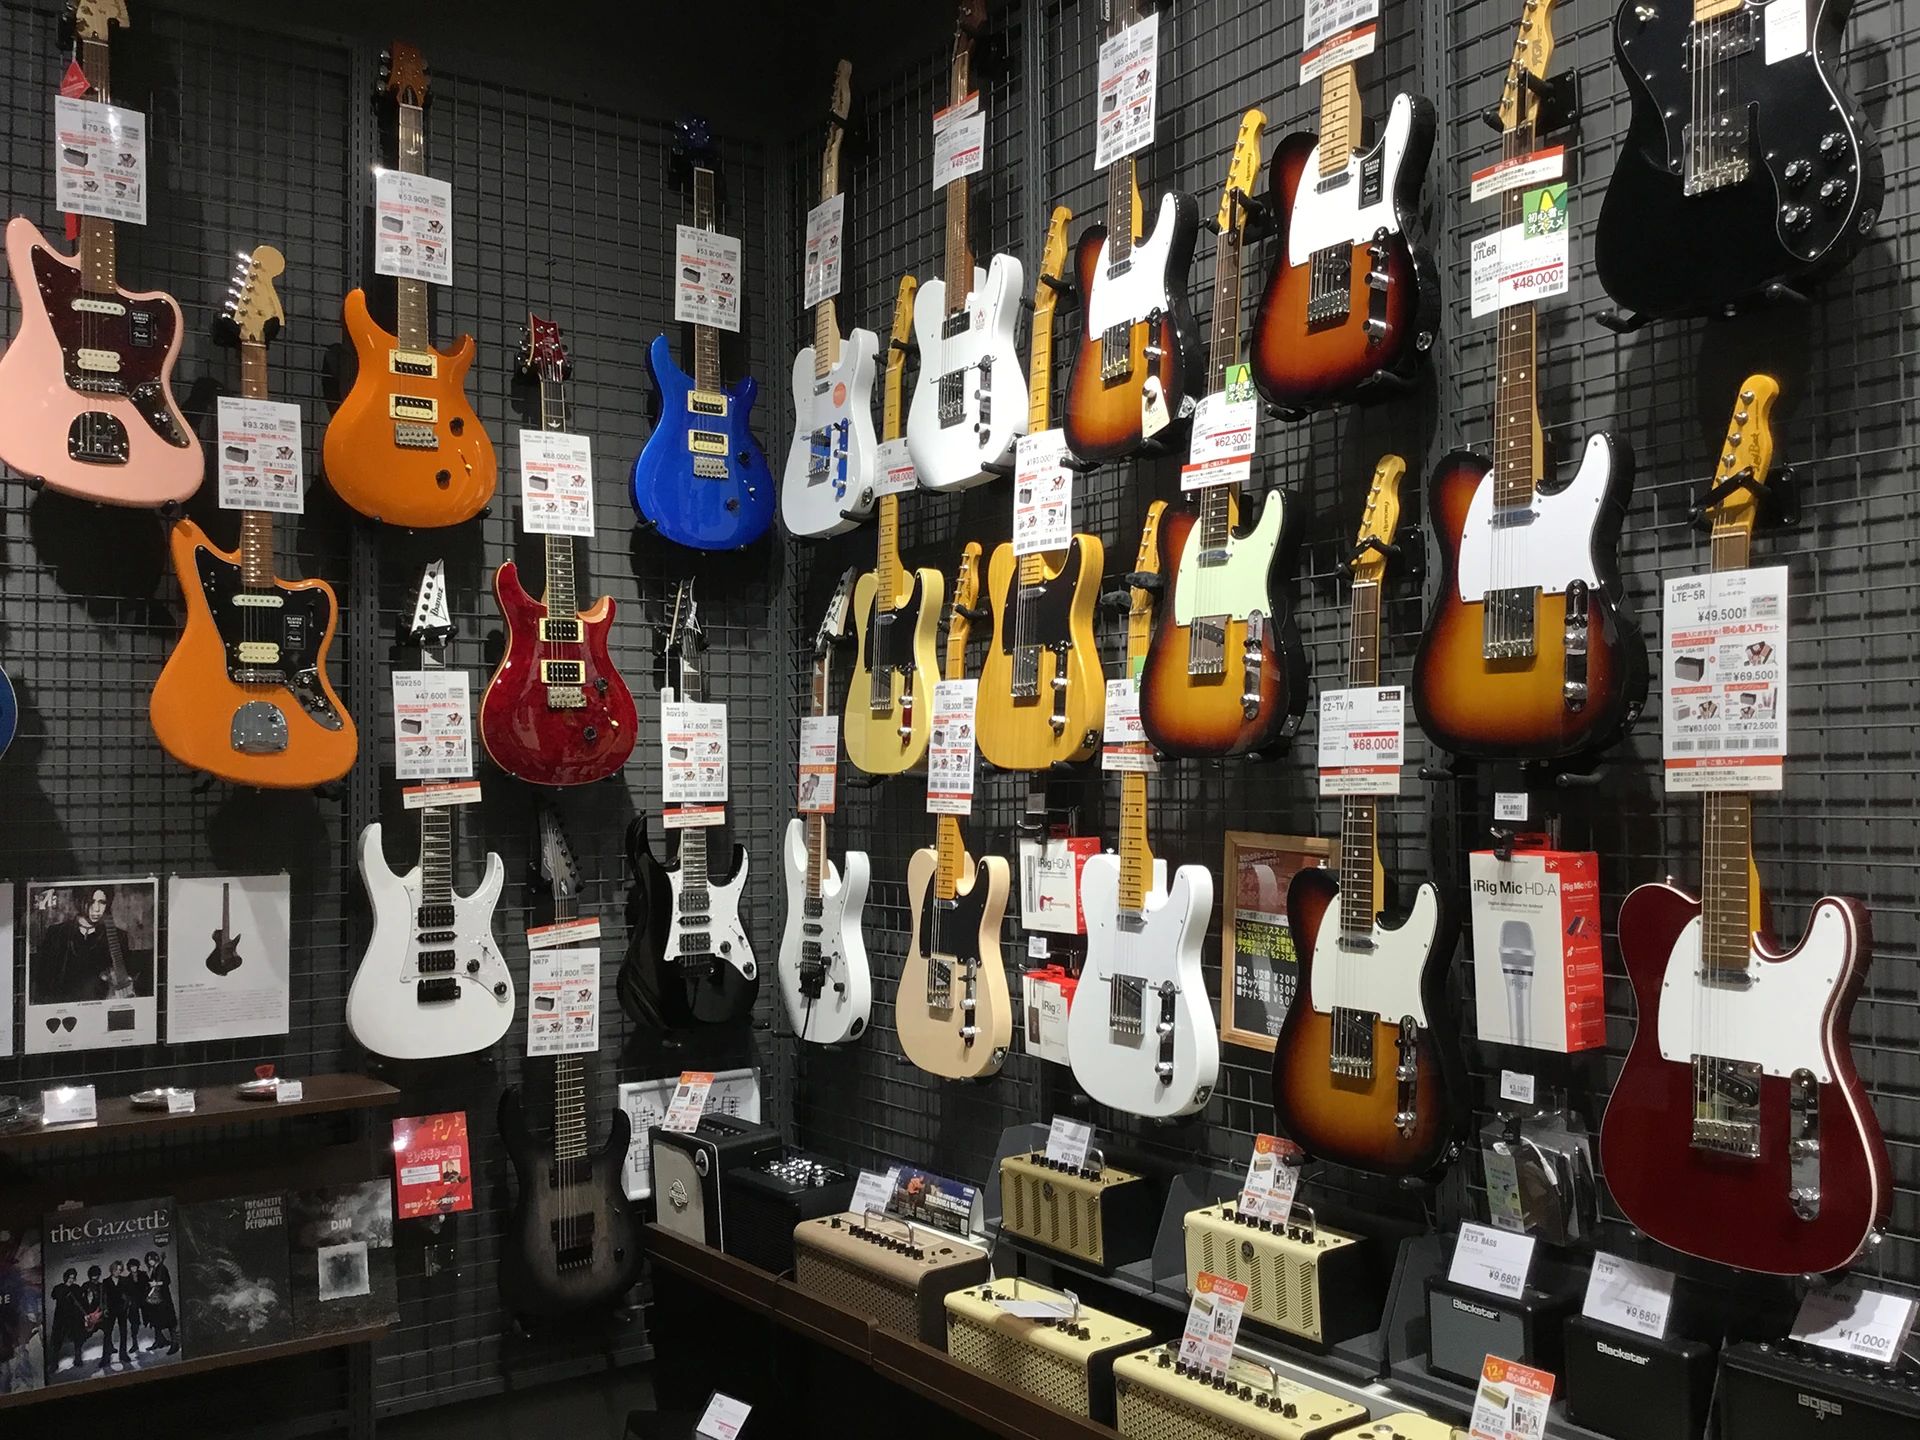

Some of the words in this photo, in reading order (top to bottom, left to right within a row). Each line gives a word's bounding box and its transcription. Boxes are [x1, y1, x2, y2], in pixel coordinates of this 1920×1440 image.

[1528, 218, 1564, 235] オススメ
[1473, 240, 1486, 251] FGN
[1474, 245, 1497, 262] JTL6R
[430, 588, 443, 616] Ibanez
[1672, 590, 1705, 603] LTE-5R
[1323, 701, 1354, 712] CZ-TV/R
[1474, 880, 1497, 896] iRig
[1499, 881, 1523, 894] Mic
[1525, 882, 1557, 896] HD-A
[331, 1218, 352, 1230] DIM
[50, 1224, 82, 1243] the
[1464, 1233, 1478, 1243] FLY3
[1481, 1237, 1497, 1248] BASS
[1453, 1298, 1498, 1319] Blackstar
[1597, 1341, 1648, 1365] Blackstar
[1798, 1393, 1842, 1415] BOSS
